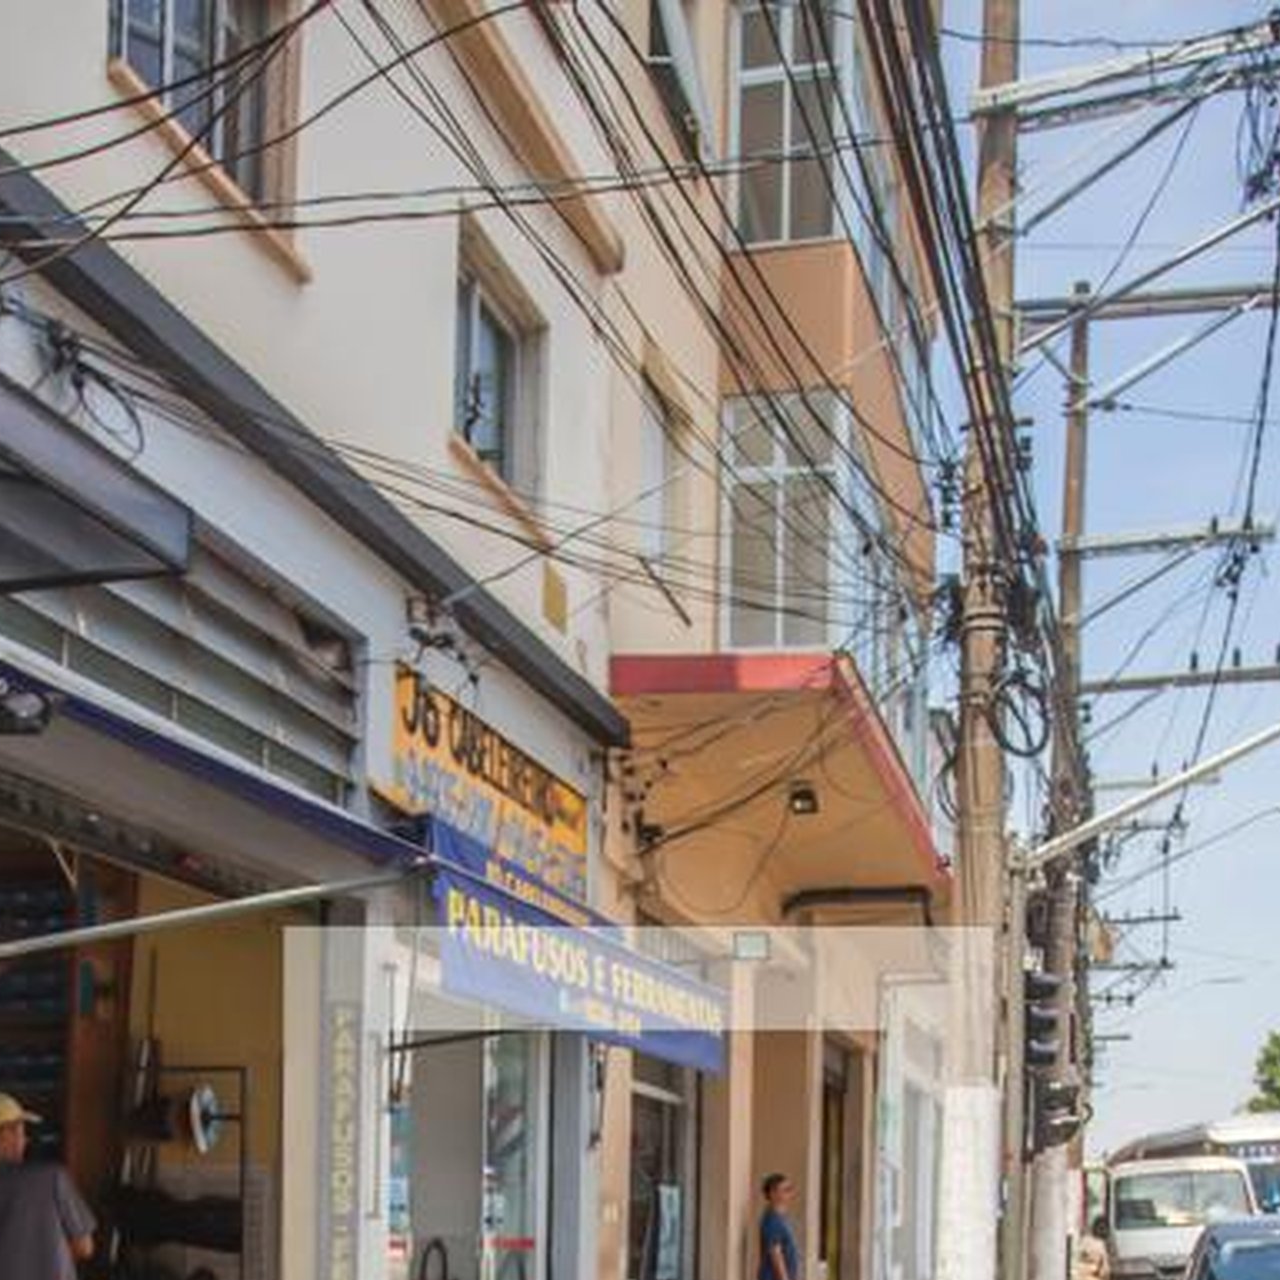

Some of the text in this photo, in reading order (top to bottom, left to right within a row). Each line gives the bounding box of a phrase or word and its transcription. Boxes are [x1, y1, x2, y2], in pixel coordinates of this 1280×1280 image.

[447, 887, 588, 988] PARAFUSOS
[592, 953, 607, 995] E
[331, 1006, 356, 1216] PARAFUSOS
